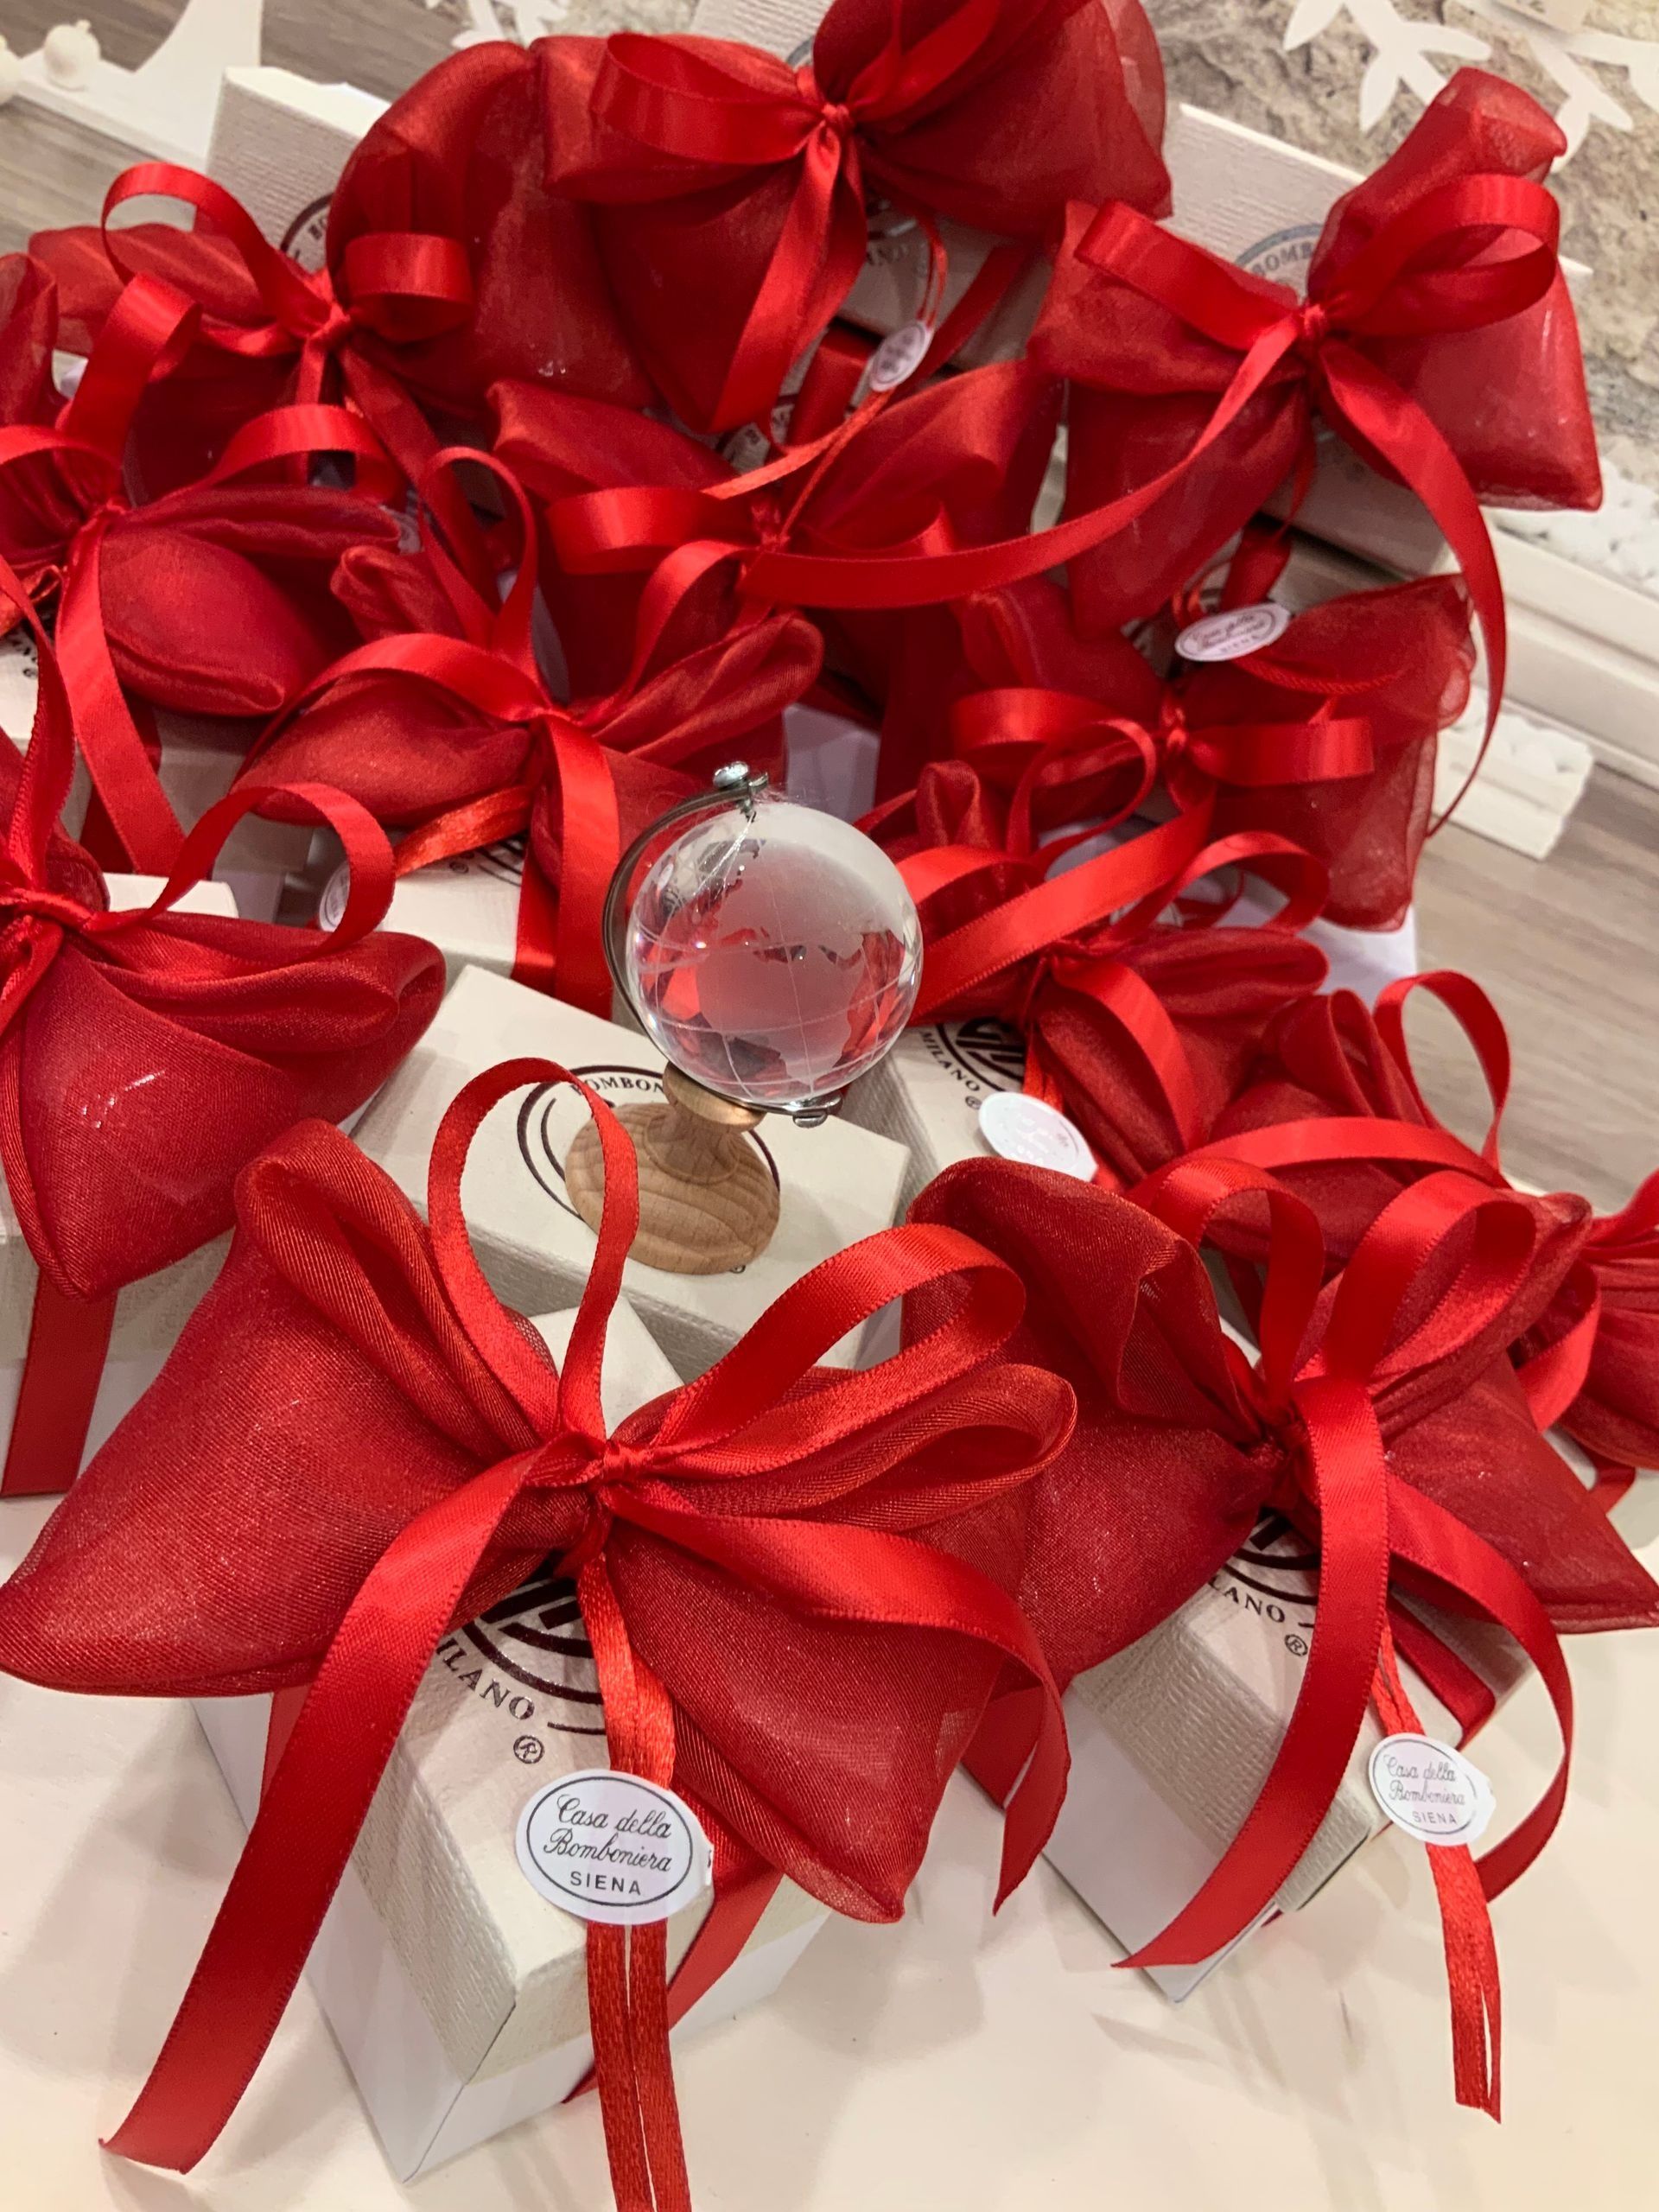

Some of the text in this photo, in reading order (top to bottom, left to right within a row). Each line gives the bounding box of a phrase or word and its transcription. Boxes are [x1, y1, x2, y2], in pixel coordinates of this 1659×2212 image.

[919, 1027, 980, 1092] MILANO
[1382, 1754, 1456, 1782] Casa della
[1389, 1779, 1465, 1806] Bomboniera
[556, 1794, 672, 1840] Casa della
[1412, 1811, 1458, 1825] SIENA
[543, 1827, 673, 1872] Bomboniera
[569, 1871, 641, 1896] SIENA
